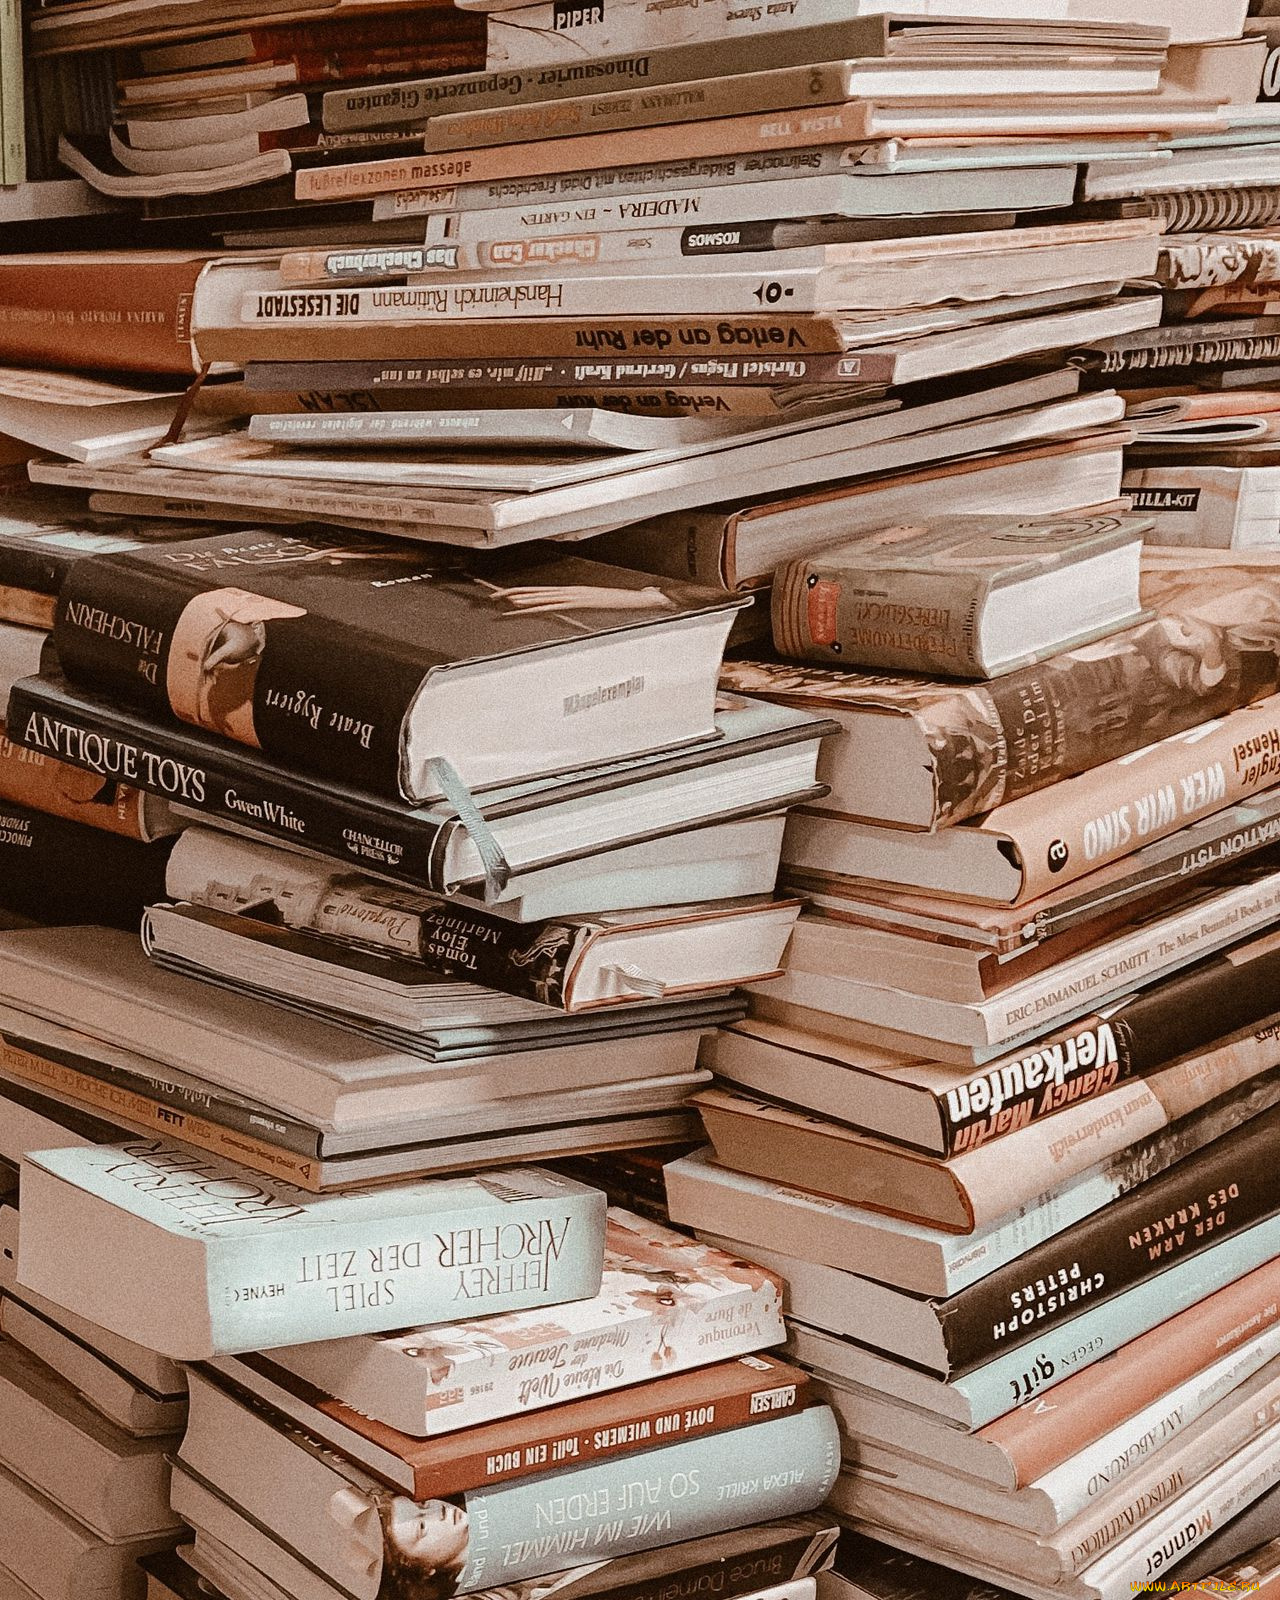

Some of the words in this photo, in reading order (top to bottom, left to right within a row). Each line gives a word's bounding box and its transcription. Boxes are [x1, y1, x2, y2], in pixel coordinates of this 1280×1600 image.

[556, 7, 602, 31] PIPER
[541, 57, 651, 87] Dinosaurier
[347, 87, 420, 112] Giganten
[424, 72, 523, 104] Gepanzerte
[412, 158, 472, 180] massage
[521, 209, 571, 226] GARTEN
[575, 208, 596, 221] EIN
[619, 196, 701, 219] MADEIRA
[688, 231, 741, 247] KOSMOS
[425, 245, 459, 269] Das
[257, 293, 332, 318] LESESTADT
[334, 293, 360, 317] DIE
[455, 284, 564, 312] Hansheinrich
[576, 328, 628, 351] Ruhr
[633, 326, 672, 348] der
[679, 328, 712, 345] an
[718, 322, 807, 349] Verlag
[426, 366, 466, 383] selbst
[575, 364, 612, 381] Kraft
[615, 362, 677, 380] Gertrud
[743, 359, 807, 379] Christel
[638, 393, 662, 408] an
[682, 389, 732, 413] Verlag
[370, 573, 433, 589] Roman
[66, 600, 163, 655] FÄLSCHERIN
[328, 711, 375, 750] Beate
[24, 711, 138, 779] ANTIQUE
[141, 751, 207, 804] TOYS
[1232, 729, 1280, 773] Hensel
[1179, 761, 1227, 814] WER
[223, 788, 262, 818] Gwen
[263, 802, 306, 834] White
[1133, 784, 1177, 835] WIR
[342, 827, 404, 857] CHANCELLOR
[430, 926, 469, 952] Eloy
[1005, 974, 1100, 1026] ERIC-EMMANUEL
[1100, 949, 1152, 981] SCHMITT
[1157, 940, 1175, 957] The
[1176, 929, 1201, 948] Most
[1200, 909, 1240, 935] Beautiful
[1239, 899, 1262, 922] Book
[946, 1022, 1119, 1123] Verkaufen
[1039, 1061, 1119, 1115] Clancy
[157, 1106, 186, 1128] FETT
[953, 1096, 1035, 1153] Martin
[1207, 1182, 1240, 1211] DES
[1127, 1201, 1202, 1250] KRAKEN
[1195, 1210, 1226, 1238] DER
[370, 1240, 422, 1273] DER
[433, 1216, 573, 1270] ARCHER
[1148, 1231, 1186, 1260] ARM
[300, 1248, 360, 1284] ZEIT
[452, 1258, 550, 1301] JEFFREY
[239, 1282, 286, 1301] HEYNE
[333, 1278, 396, 1313] SPIEL
[1010, 1261, 1082, 1310] PETERS
[704, 1306, 735, 1325] Bure
[735, 1302, 754, 1320] de
[992, 1271, 1106, 1341] CHRISTOPH
[571, 1327, 632, 1353] Madame
[697, 1320, 764, 1348] Veronique
[507, 1341, 568, 1372] Jeanne
[569, 1351, 590, 1369] der
[1059, 1335, 1105, 1370] GEGEN
[563, 1363, 602, 1390] kleine
[603, 1359, 625, 1378] Die
[1009, 1352, 1056, 1404] gift
[517, 1369, 562, 1406] Welt
[750, 1388, 798, 1415] CARLSEN
[655, 1412, 681, 1435] UND
[683, 1405, 716, 1431] DOYÉ
[1155, 1403, 1186, 1438] AM
[593, 1419, 652, 1450] WIEMERS
[486, 1452, 522, 1476] BUCH
[525, 1445, 548, 1466] EIN
[551, 1439, 581, 1463] Toll!
[1086, 1424, 1159, 1499] ABGRUND
[669, 1468, 701, 1500] SO
[717, 1477, 760, 1501] KRIELE
[760, 1467, 805, 1492] ALEXA
[535, 1486, 610, 1528] ERDEN
[616, 1476, 662, 1512] AUF
[474, 1508, 490, 1541] und
[594, 1518, 624, 1545] IM
[626, 1508, 673, 1539] WIE
[500, 1523, 590, 1567] HIMMEL
[729, 1554, 783, 1582] Bruce
